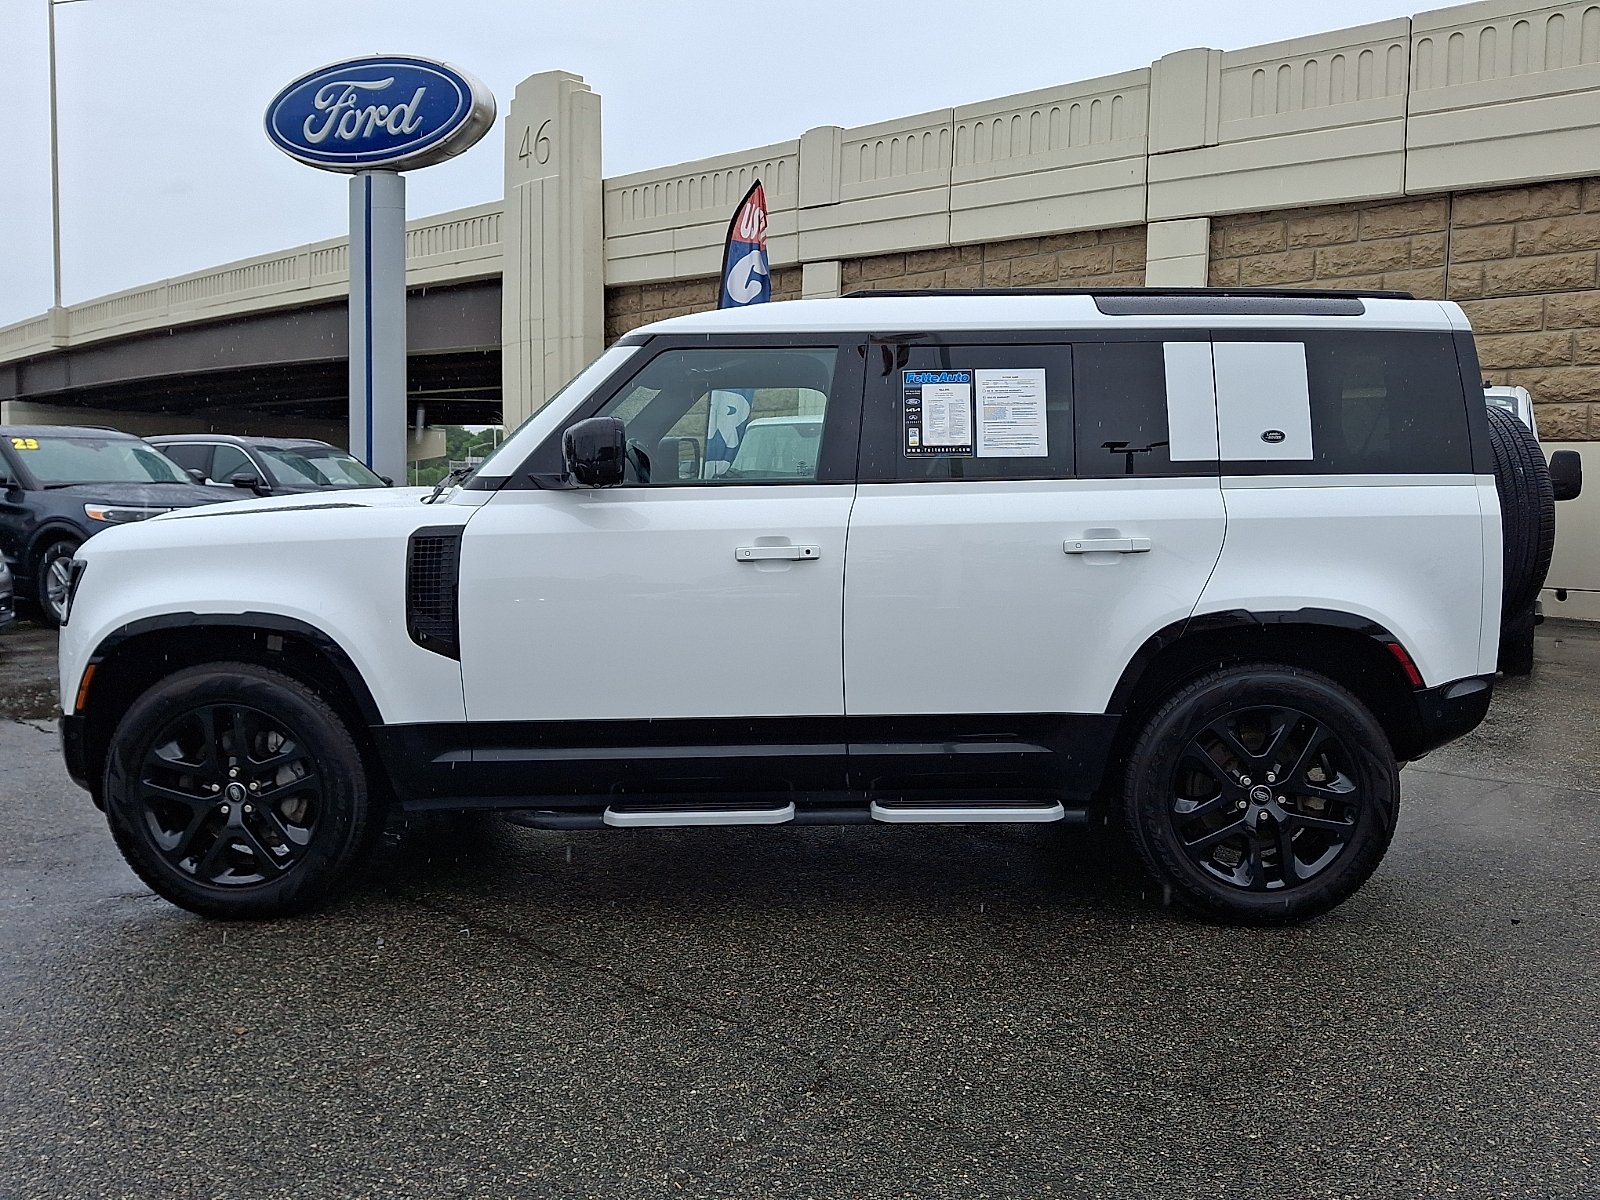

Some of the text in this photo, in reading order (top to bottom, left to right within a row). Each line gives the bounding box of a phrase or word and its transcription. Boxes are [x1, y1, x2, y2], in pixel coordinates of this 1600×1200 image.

[303, 77, 427, 144] Ford
[518, 118, 552, 169] 46
[906, 372, 970, 383] FetteAuto
[11, 438, 40, 450] 23
